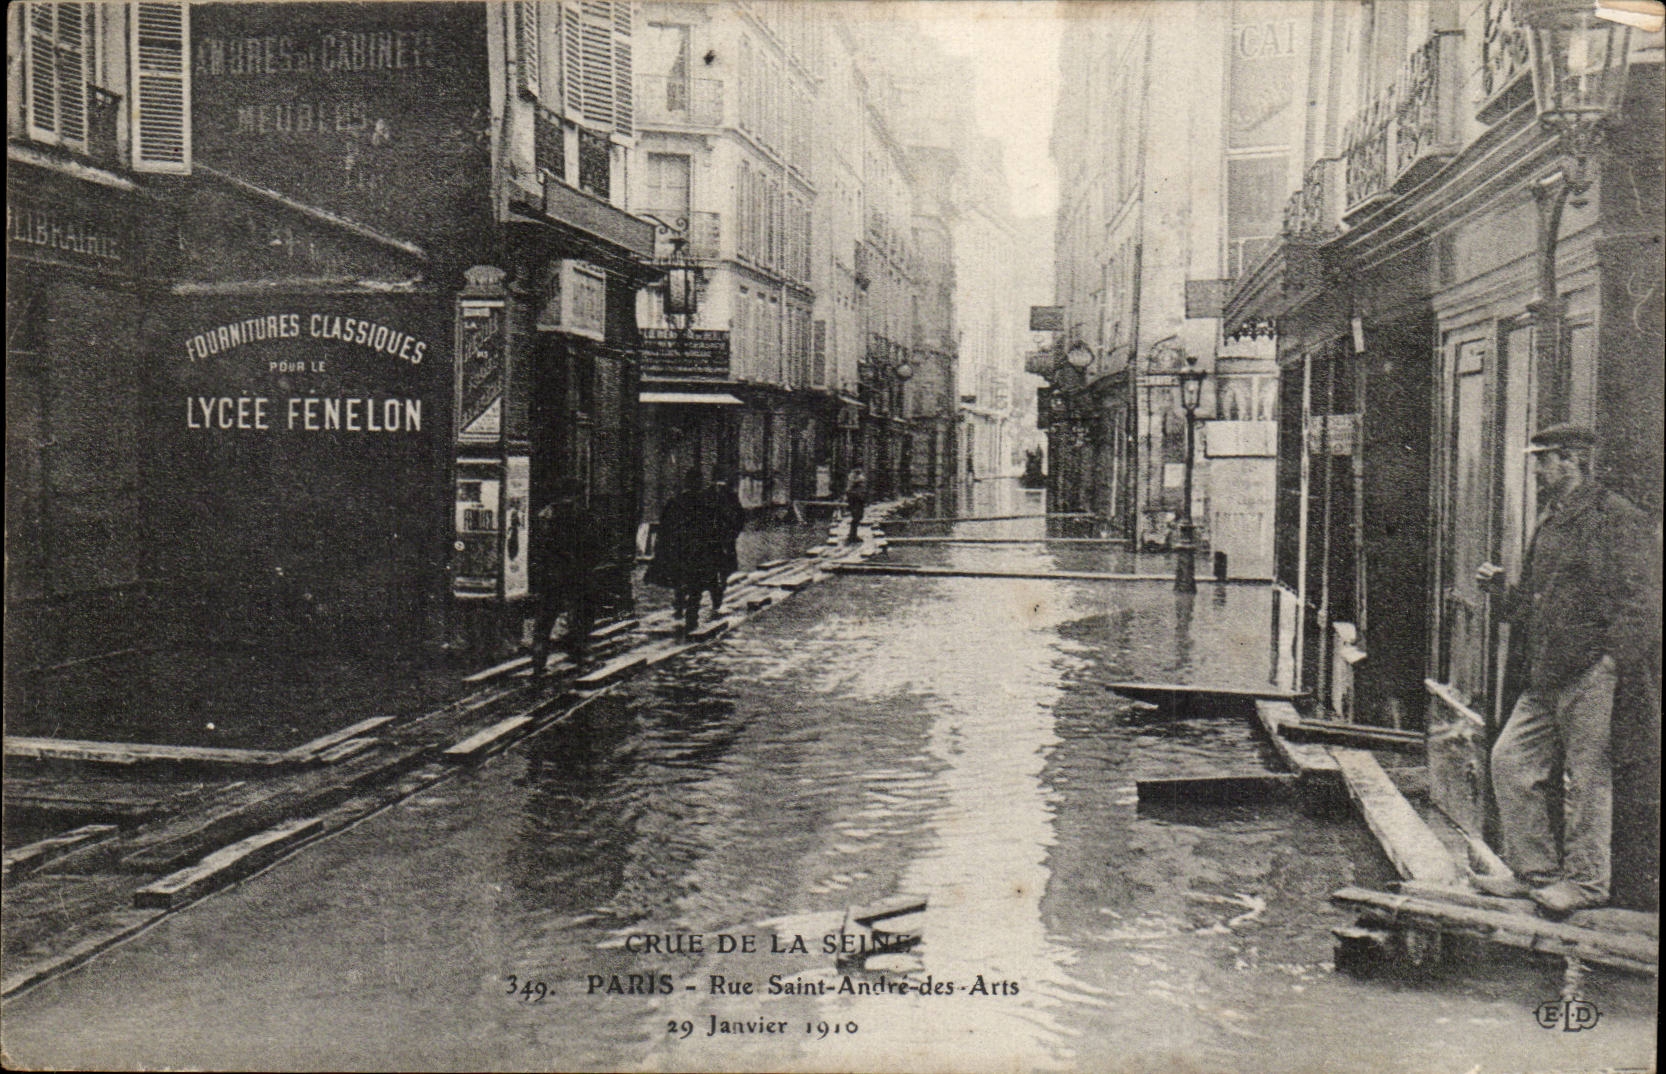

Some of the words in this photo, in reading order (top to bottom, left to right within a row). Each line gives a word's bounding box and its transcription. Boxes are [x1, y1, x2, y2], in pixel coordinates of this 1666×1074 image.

[185, 314, 300, 361] FOURNITURES
[310, 314, 427, 364] CLASSIQUES
[269, 361, 305, 372] POUR
[311, 362, 326, 372] LE
